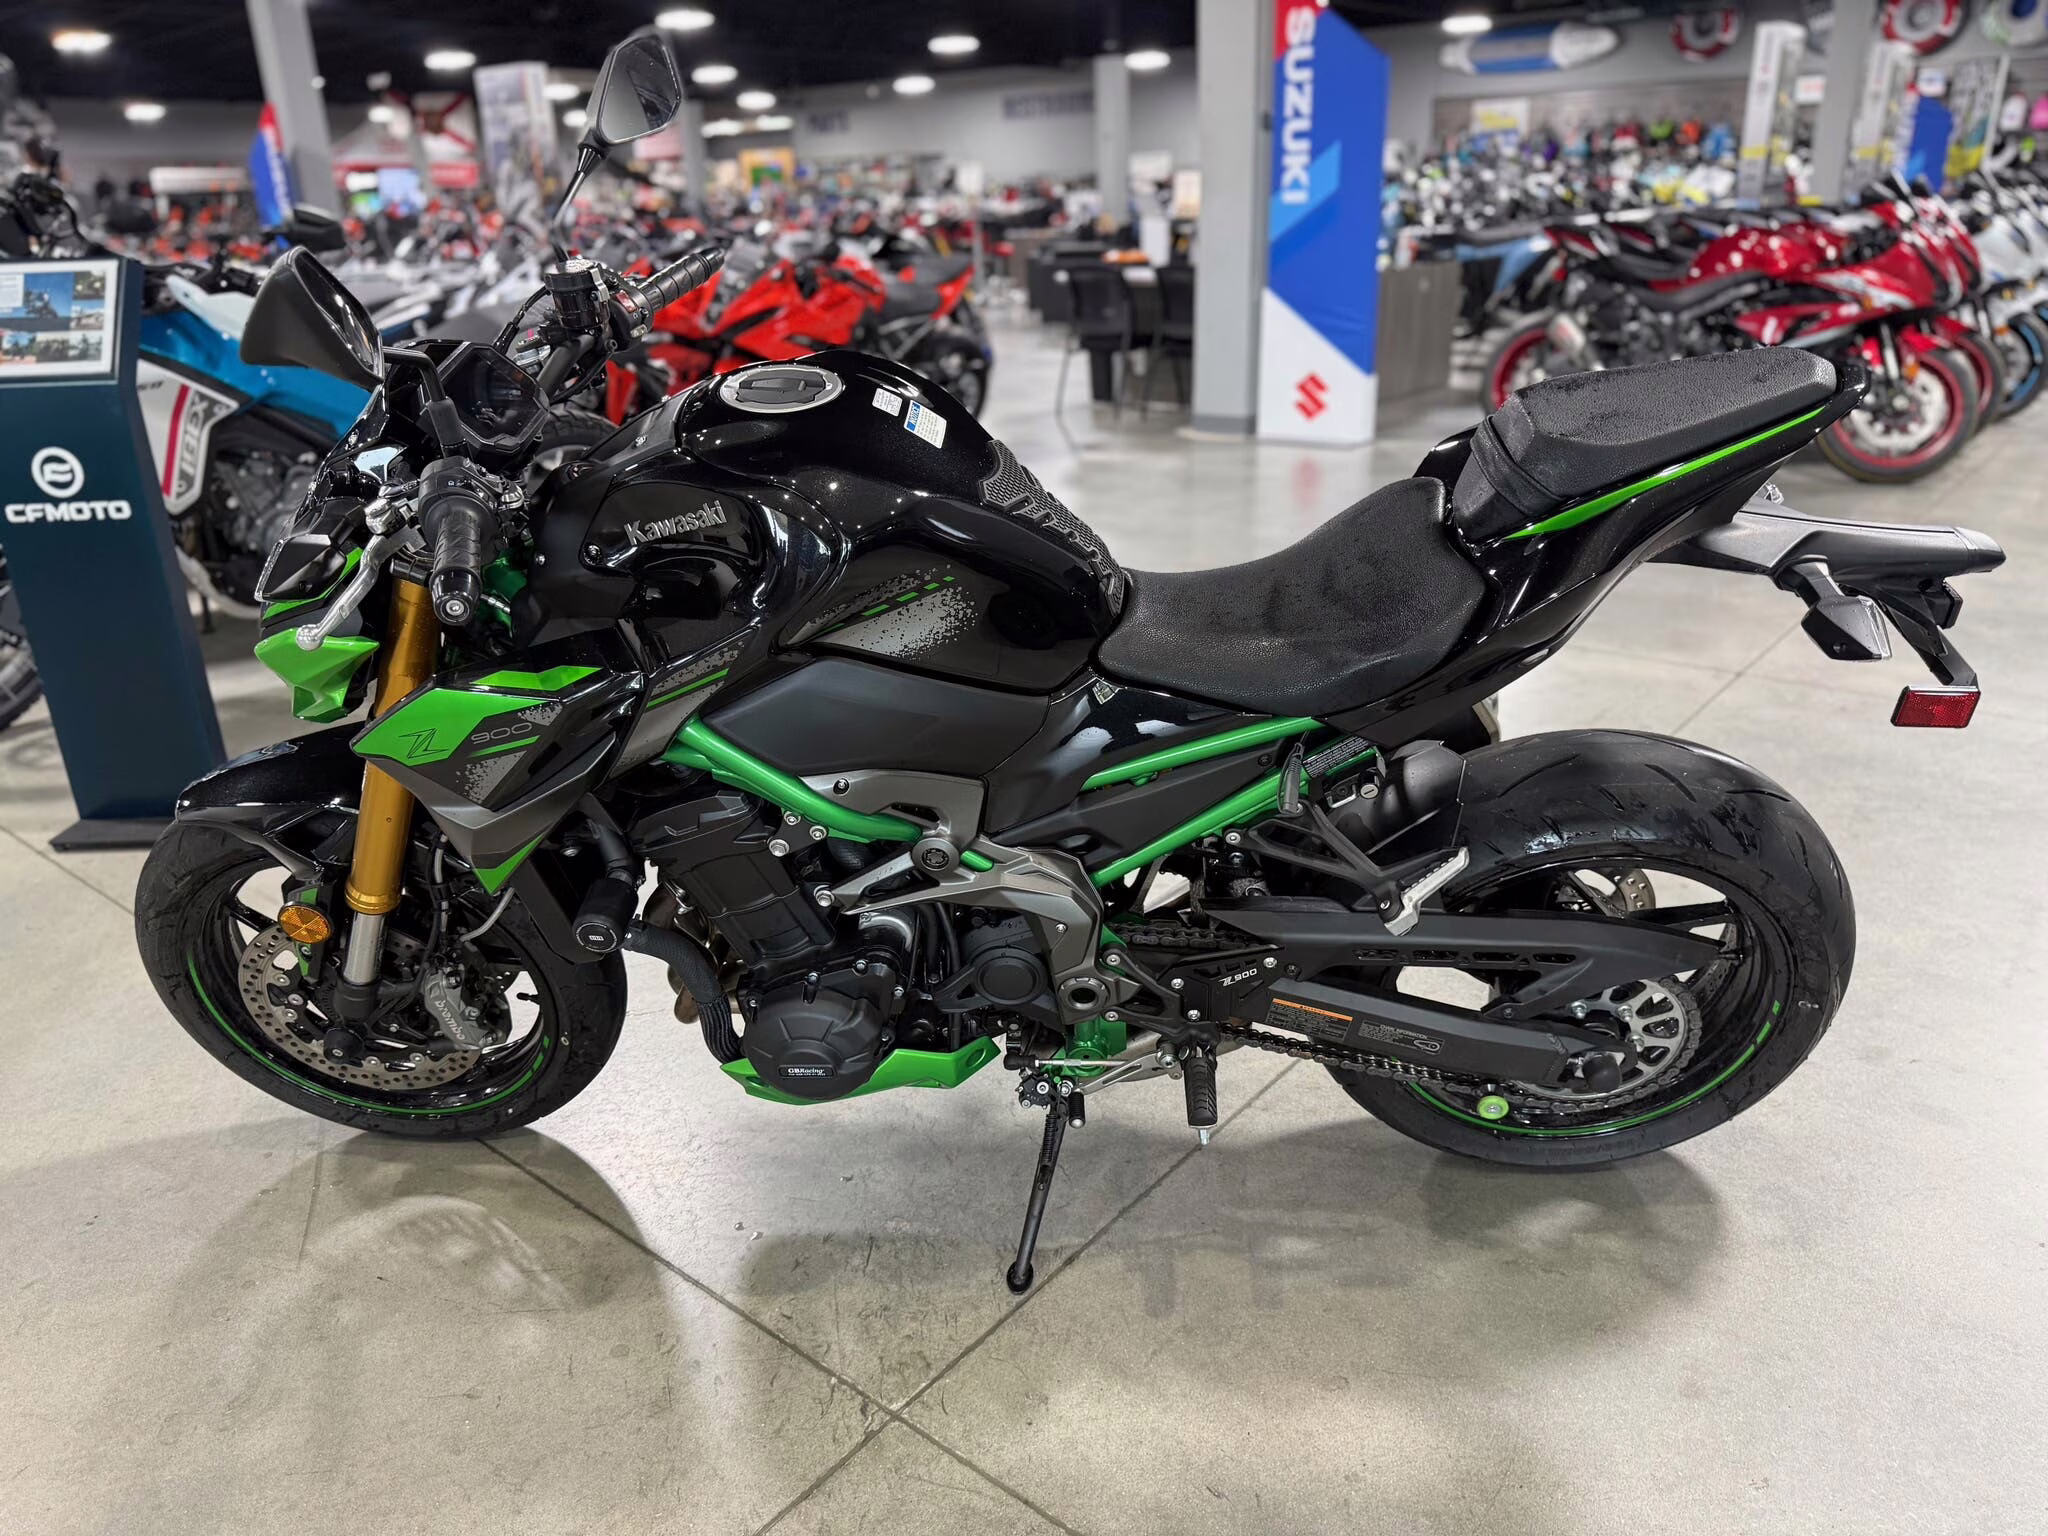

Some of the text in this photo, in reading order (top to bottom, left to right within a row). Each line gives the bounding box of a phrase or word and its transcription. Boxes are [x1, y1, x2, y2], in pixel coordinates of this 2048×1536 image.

[1281, 6, 1316, 204] SUZUKI
[5, 500, 132, 523] CFMOTO
[624, 500, 727, 546] Kawasaki
[471, 722, 533, 745] 900
[434, 1000, 466, 1040] brembo
